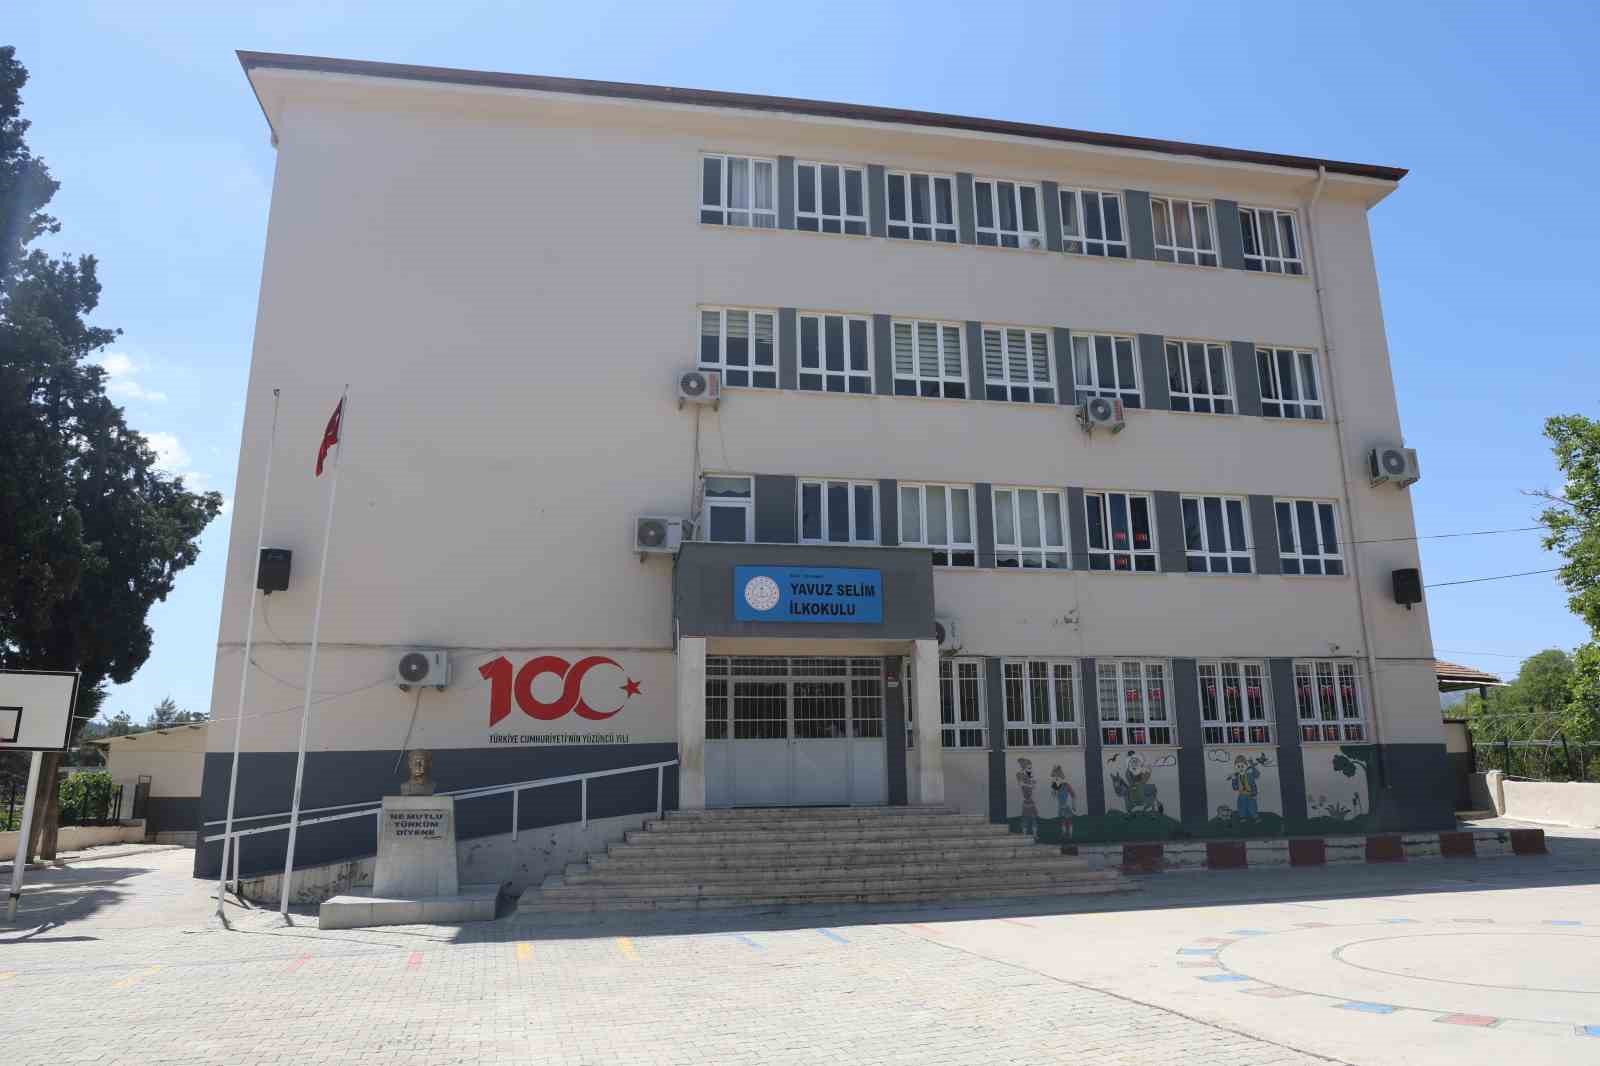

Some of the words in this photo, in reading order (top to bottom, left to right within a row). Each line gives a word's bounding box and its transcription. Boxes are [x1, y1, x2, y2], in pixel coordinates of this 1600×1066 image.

[790, 583, 833, 596] YAVUZ
[836, 582, 875, 597] SELİM
[789, 600, 856, 616] İLKOKULU
